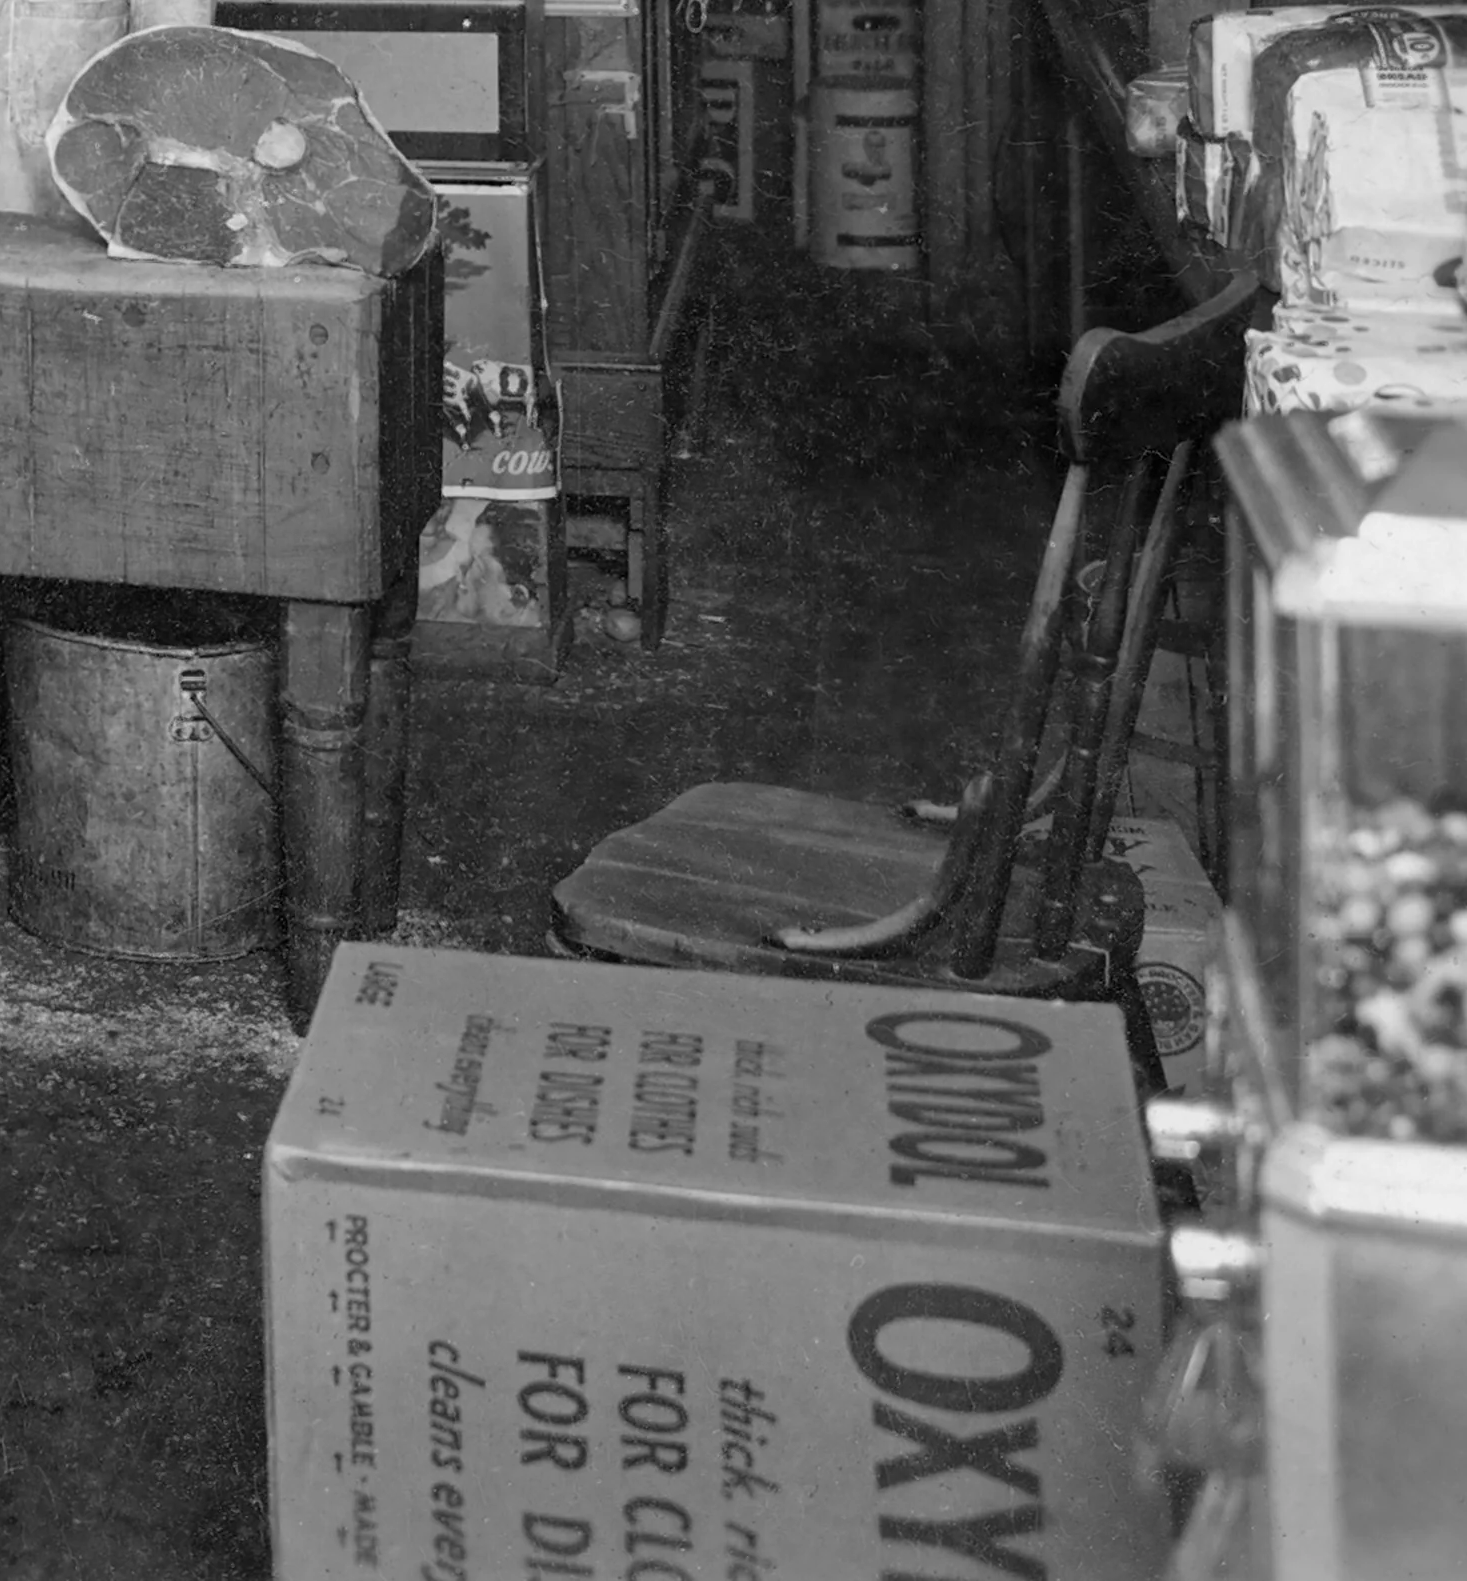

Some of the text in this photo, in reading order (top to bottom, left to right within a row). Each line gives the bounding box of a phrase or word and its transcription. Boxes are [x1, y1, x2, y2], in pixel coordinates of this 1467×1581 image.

[530, 1022, 612, 1147] FOR DISHES
[628, 1030, 704, 1158] FOR CLOTHES
[866, 1011, 1052, 1189] OXYDOL
[342, 1213, 381, 1568] PROCTER & GAMBLE MADE
[1098, 1305, 1139, 1360] 24
[419, 1338, 486, 1581] cleans every
[516, 1349, 591, 1472] FOR
[615, 1363, 692, 1475] FOR
[845, 1281, 1066, 1581] OXY
